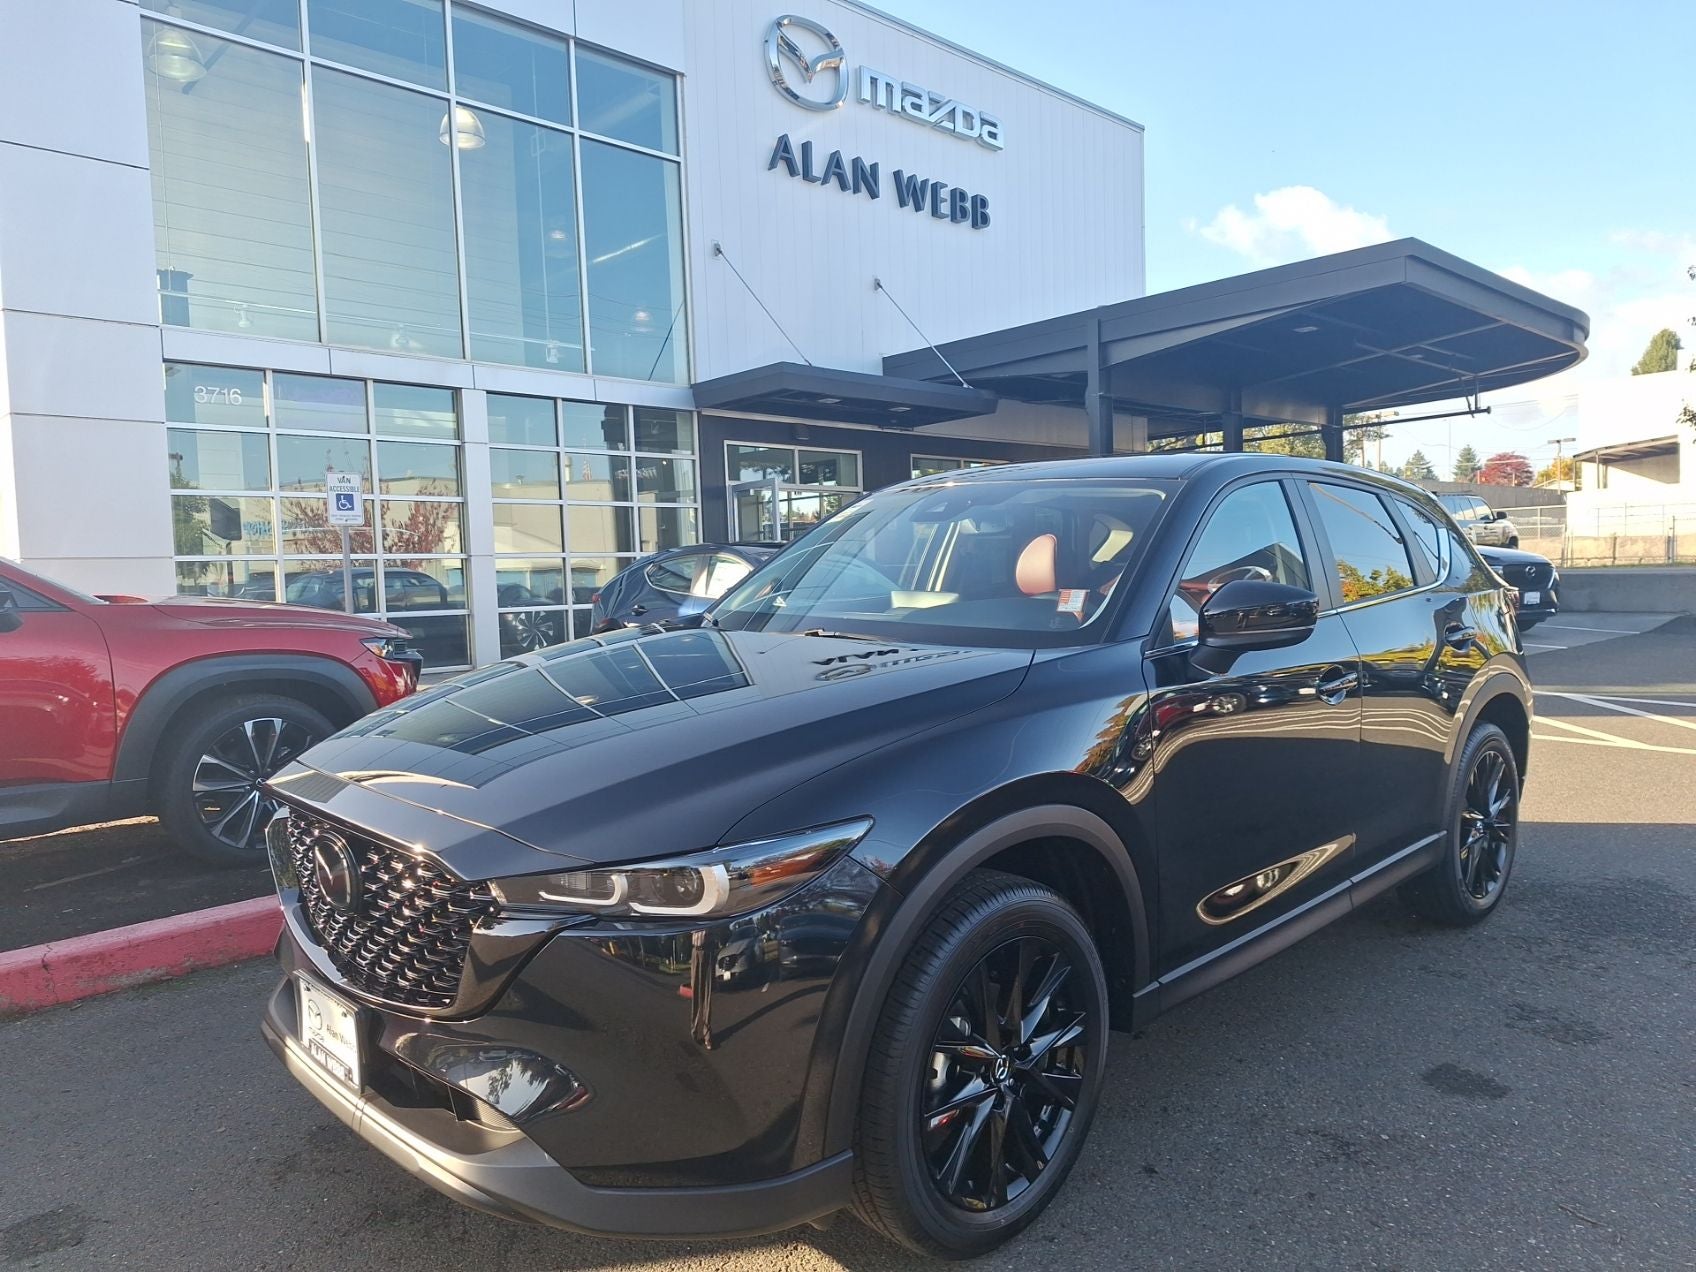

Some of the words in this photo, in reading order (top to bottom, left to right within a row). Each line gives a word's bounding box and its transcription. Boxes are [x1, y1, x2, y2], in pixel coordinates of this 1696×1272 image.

[768, 133, 880, 200] ALAN
[893, 169, 991, 229] WEBB
[194, 385, 242, 405] 3716
[337, 476, 351, 484] VAN
